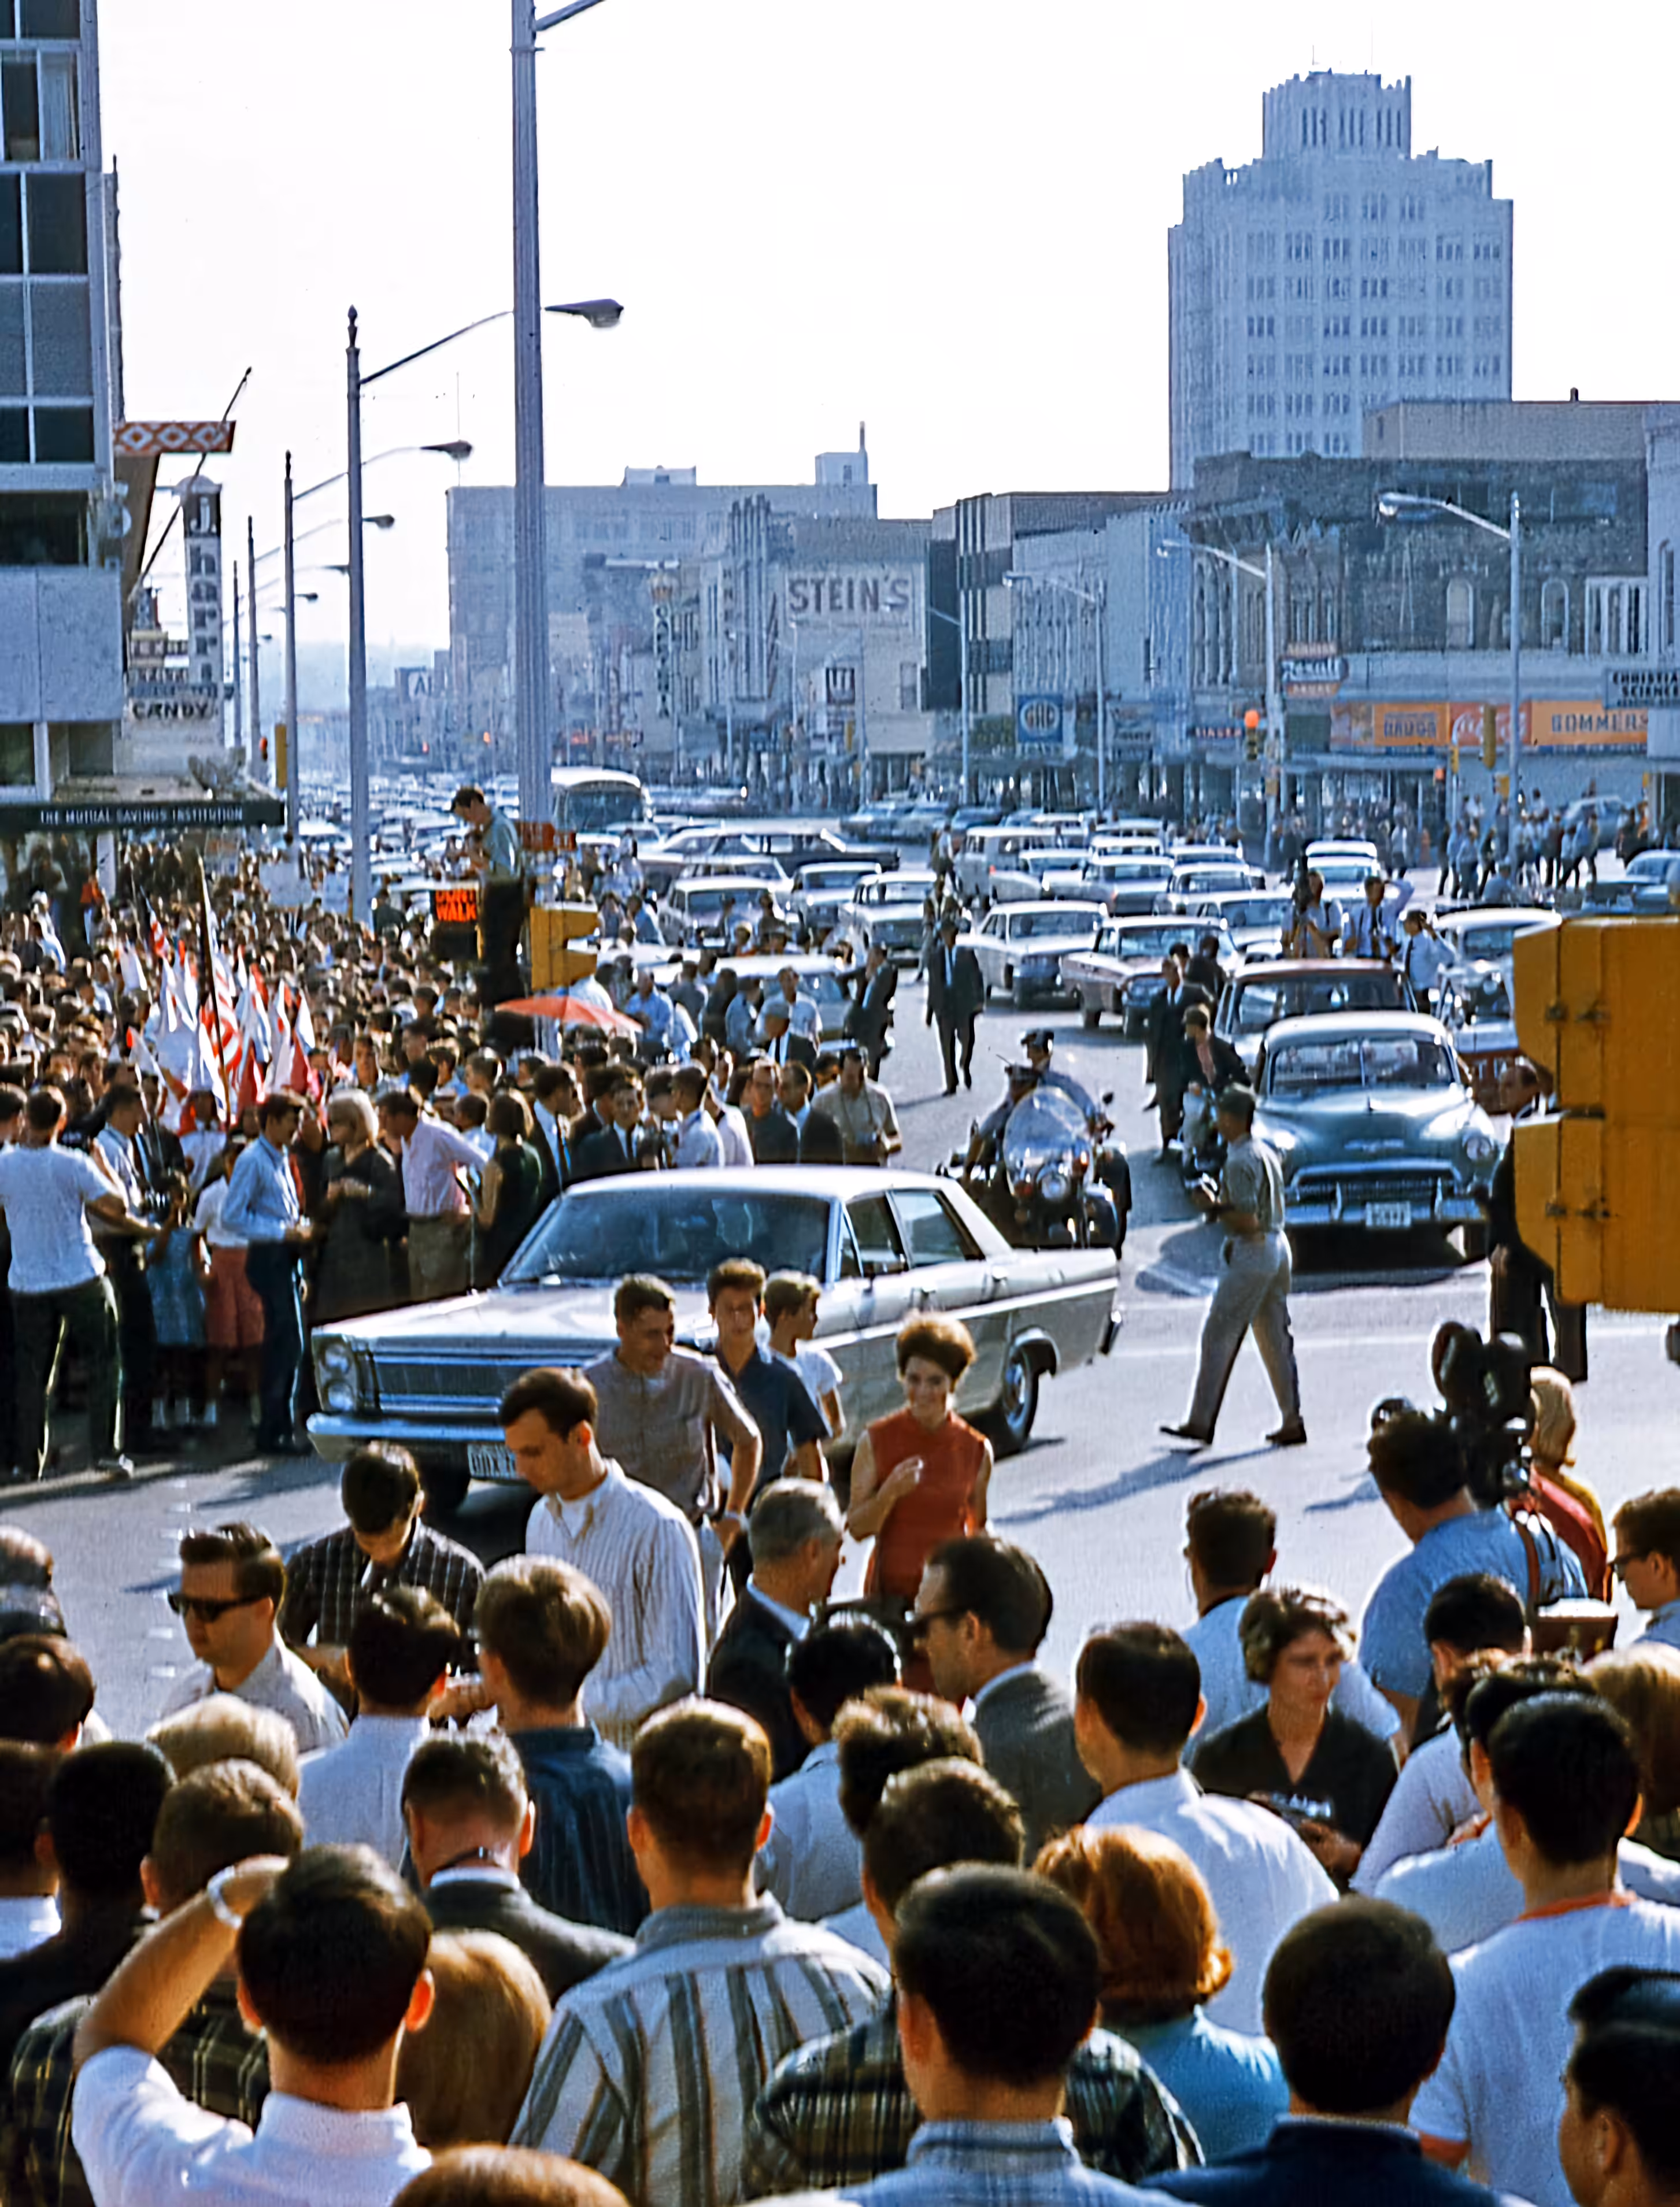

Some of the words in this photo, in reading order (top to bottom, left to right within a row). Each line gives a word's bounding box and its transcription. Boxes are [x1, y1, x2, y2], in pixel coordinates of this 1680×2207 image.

[789, 575, 909, 613] STEIN'S
[40, 809, 58, 824] THE
[66, 808, 110, 824] MUTUAL
[172, 807, 243, 824] INSTITUTION
[436, 902, 477, 921] WALK
